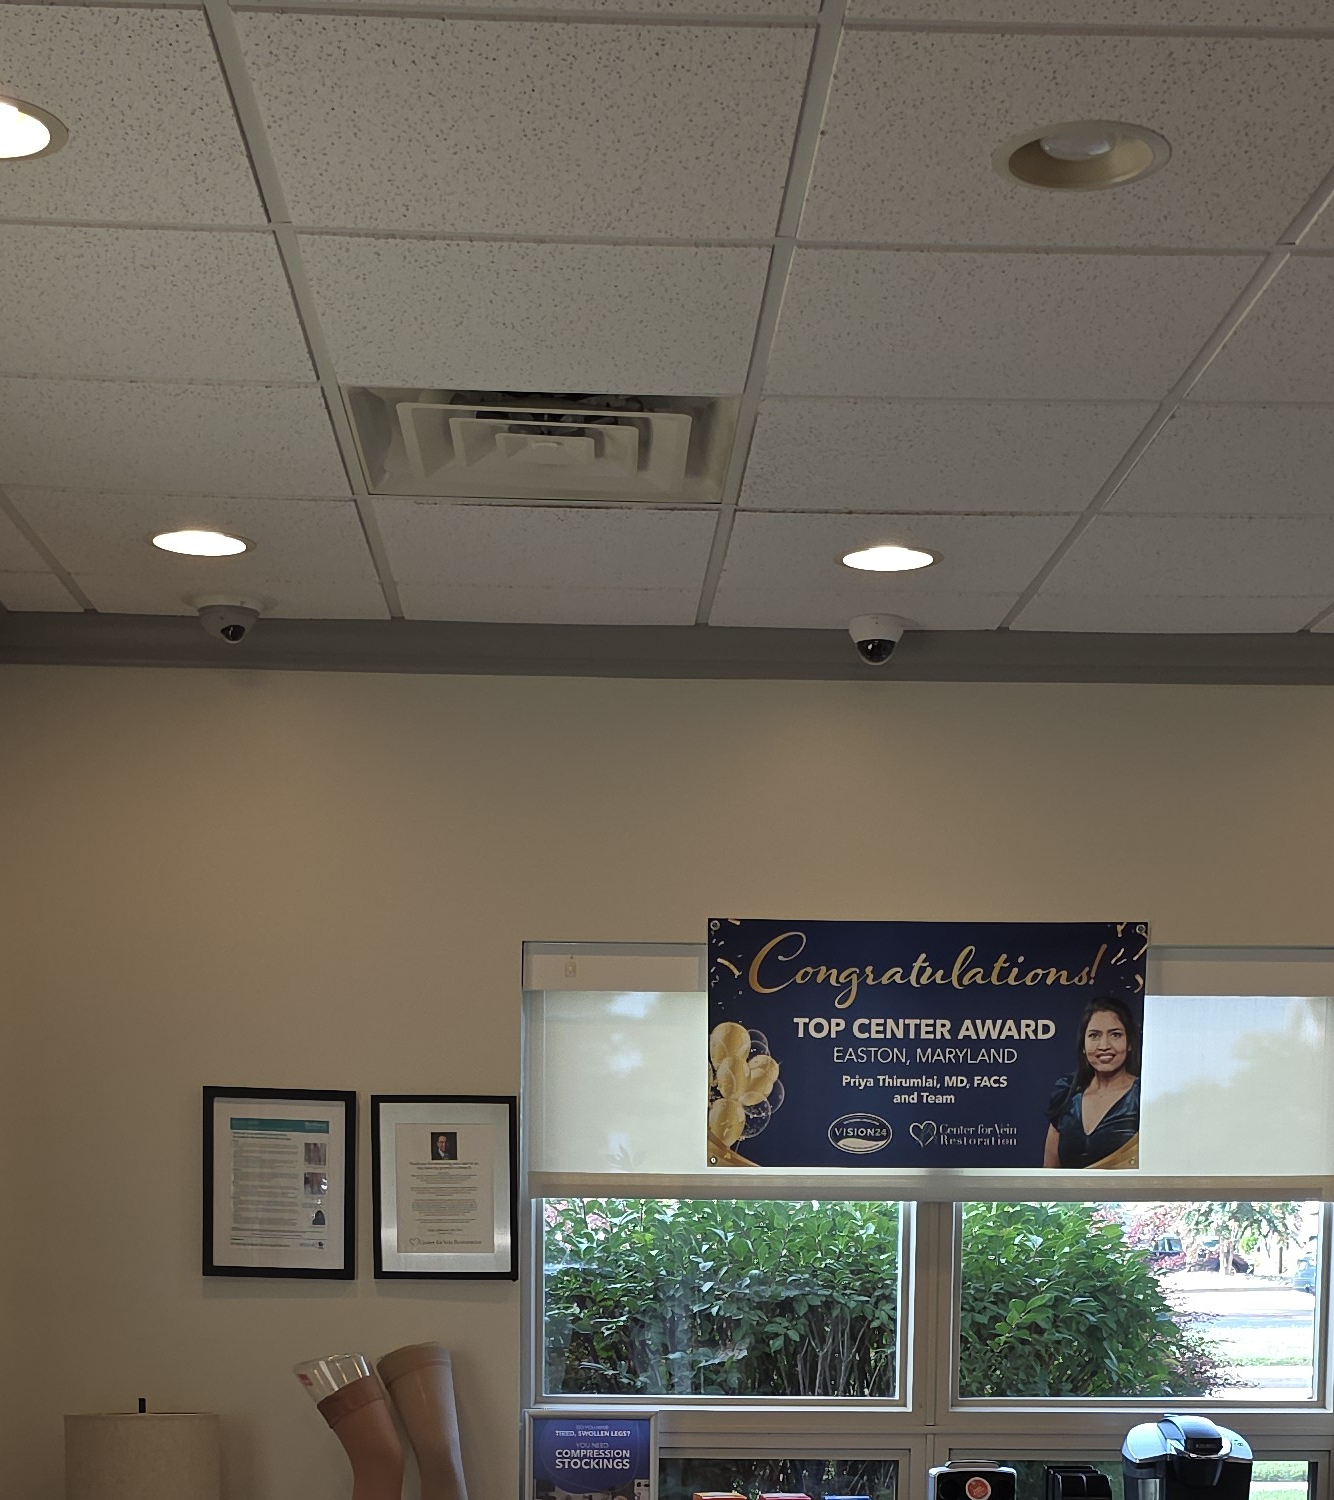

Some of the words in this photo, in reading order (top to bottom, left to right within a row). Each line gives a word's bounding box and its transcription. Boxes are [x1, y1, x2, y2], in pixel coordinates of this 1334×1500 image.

[748, 931, 1107, 1009] Congratulations!
[794, 1017, 844, 1039] TOP
[852, 1018, 951, 1040] CENTER
[958, 1019, 1056, 1040] AWARD
[833, 1047, 911, 1066] EASTON,
[915, 1047, 1017, 1064] MARYLAND
[842, 1074, 874, 1090] Priya
[944, 1075, 970, 1090] MD,
[973, 1075, 1008, 1089] FACS
[893, 1092, 918, 1104] and
[921, 1092, 956, 1104] Team
[834, 1126, 888, 1138] VISION24
[939, 1123, 975, 1136] Center
[978, 1123, 993, 1135] for
[939, 1134, 1017, 1147] Restoration
[556, 1450, 630, 1458] COMPRESSION
[555, 1459, 630, 1469] STOCKINGS
